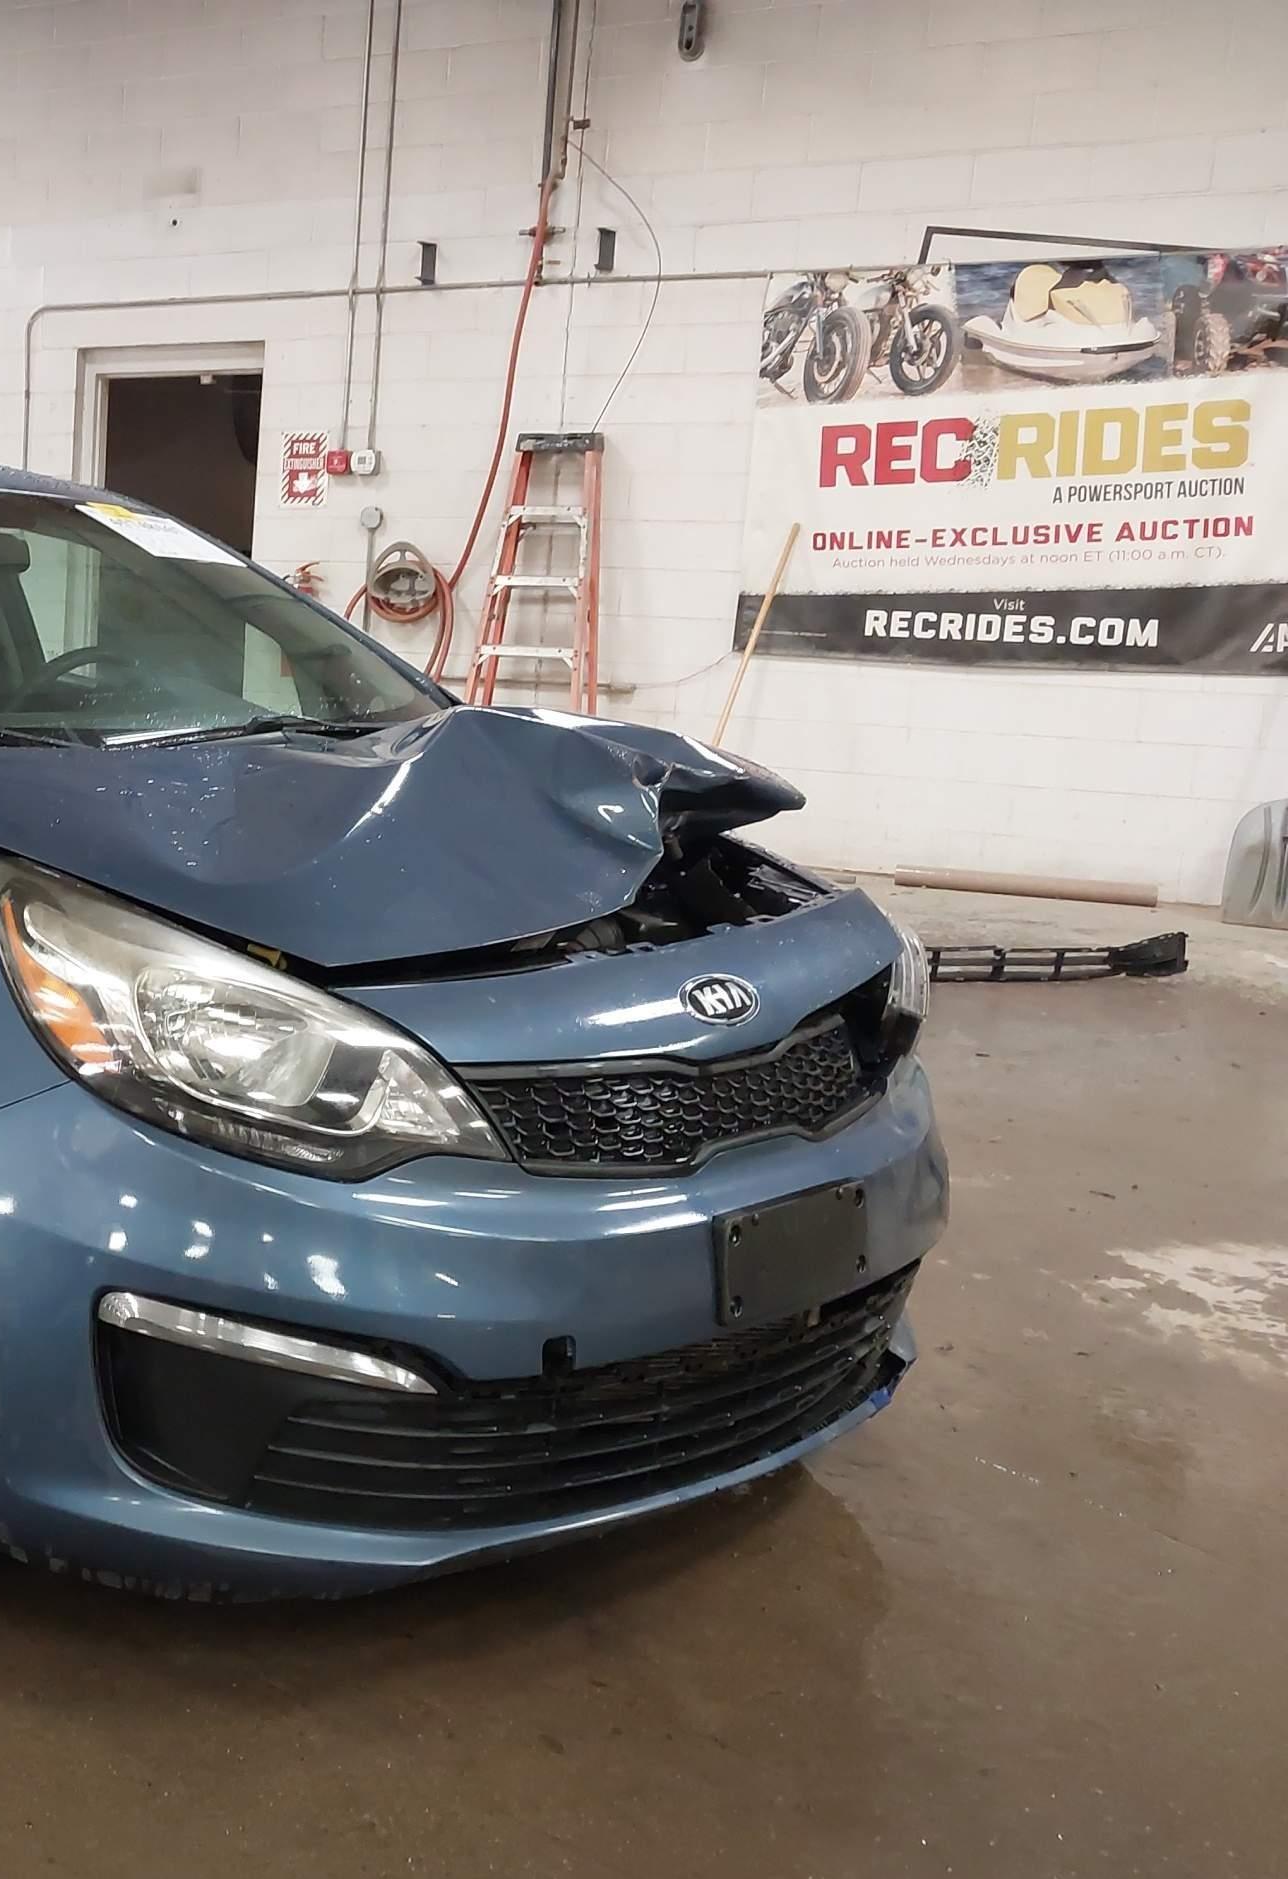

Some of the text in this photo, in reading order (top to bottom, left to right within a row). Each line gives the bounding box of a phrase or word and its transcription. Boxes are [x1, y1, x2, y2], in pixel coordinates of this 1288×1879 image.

[292, 442, 317, 456] FIRE
[819, 399, 1251, 488] REC RIDES
[1053, 477, 1245, 504] A POWERSPORT AUCTION
[812, 516, 1254, 551] ONLINE-EXCLUSIVE AUCTION
[833, 557, 885, 569] Auction
[890, 556, 920, 568] held
[925, 554, 1016, 569] Wednesdays
[1020, 553, 1035, 564] at
[1040, 554, 1079, 564] noon
[1083, 551, 1103, 563] ET
[1108, 549, 1153, 563] (11:00
[993, 598, 1026, 611] Visit
[864, 609, 1160, 648] RECRIDES.COM
